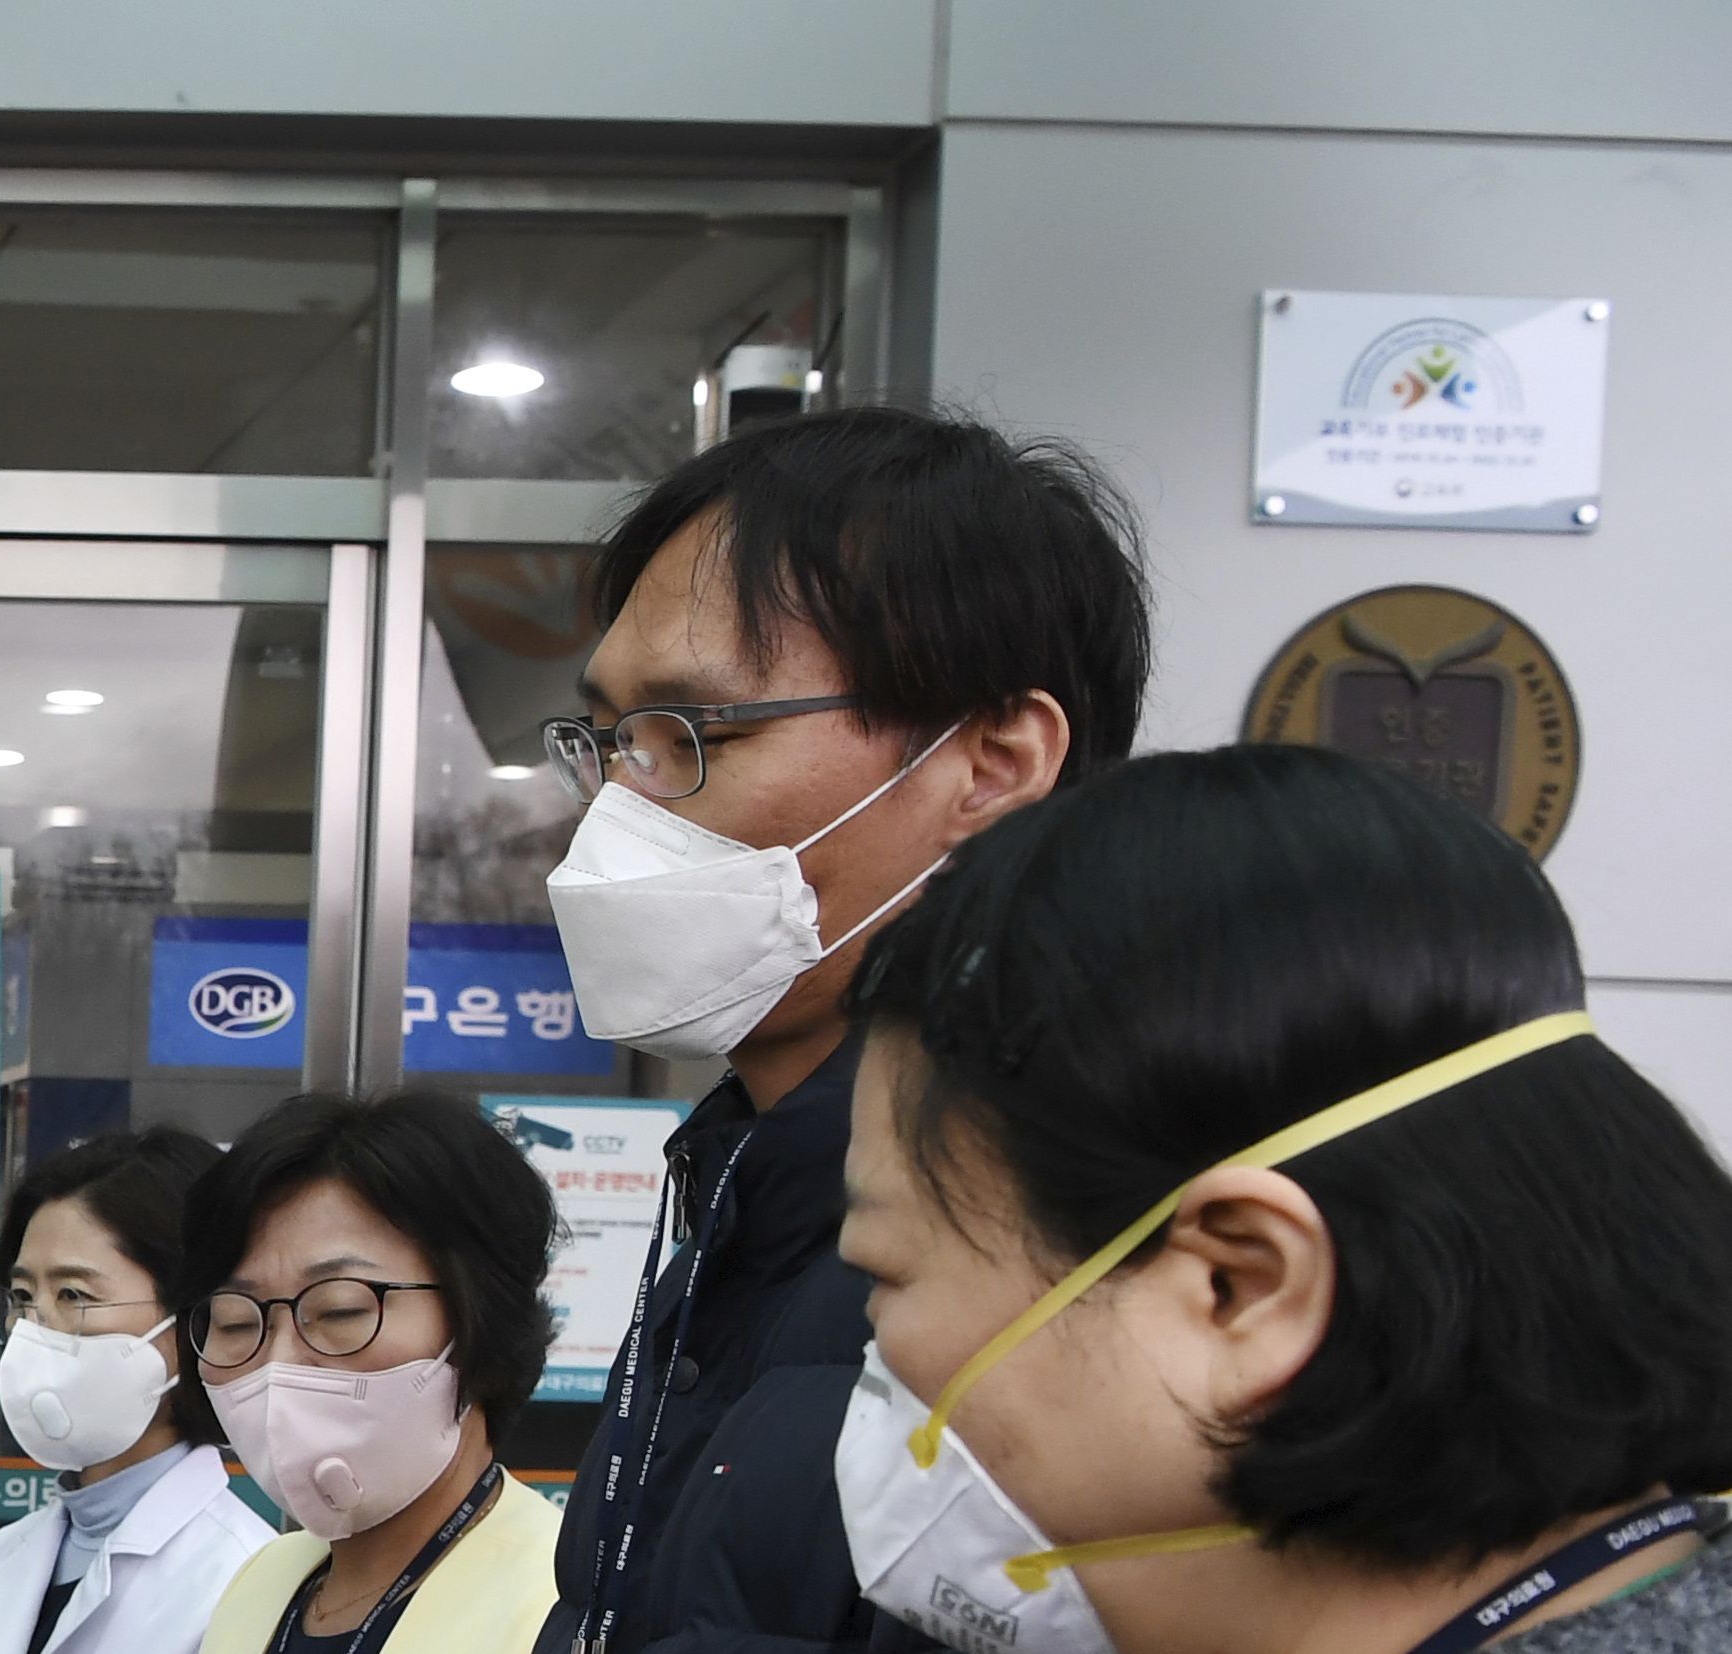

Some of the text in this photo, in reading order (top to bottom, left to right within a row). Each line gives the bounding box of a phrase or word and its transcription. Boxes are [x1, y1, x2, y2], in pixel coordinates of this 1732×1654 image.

[200, 985, 277, 1018] DGB
[584, 1136, 625, 1150] CCTV
[710, 1168, 730, 1210] DAEGU
[618, 1276, 650, 1418] DAEGU MEDICAL CENTER
[605, 1454, 622, 1501] 대구의료원
[639, 1444, 653, 1486] DAEGU
[438, 1502, 474, 1543] 대구의료원
[1606, 1517, 1662, 1552] DAEGU
[616, 1524, 634, 1571] 대구의료원
[362, 1603, 386, 1634] MEDICAL
[385, 1574, 411, 1602] CENTER
[1475, 1569, 1556, 1628] 대구의료원
